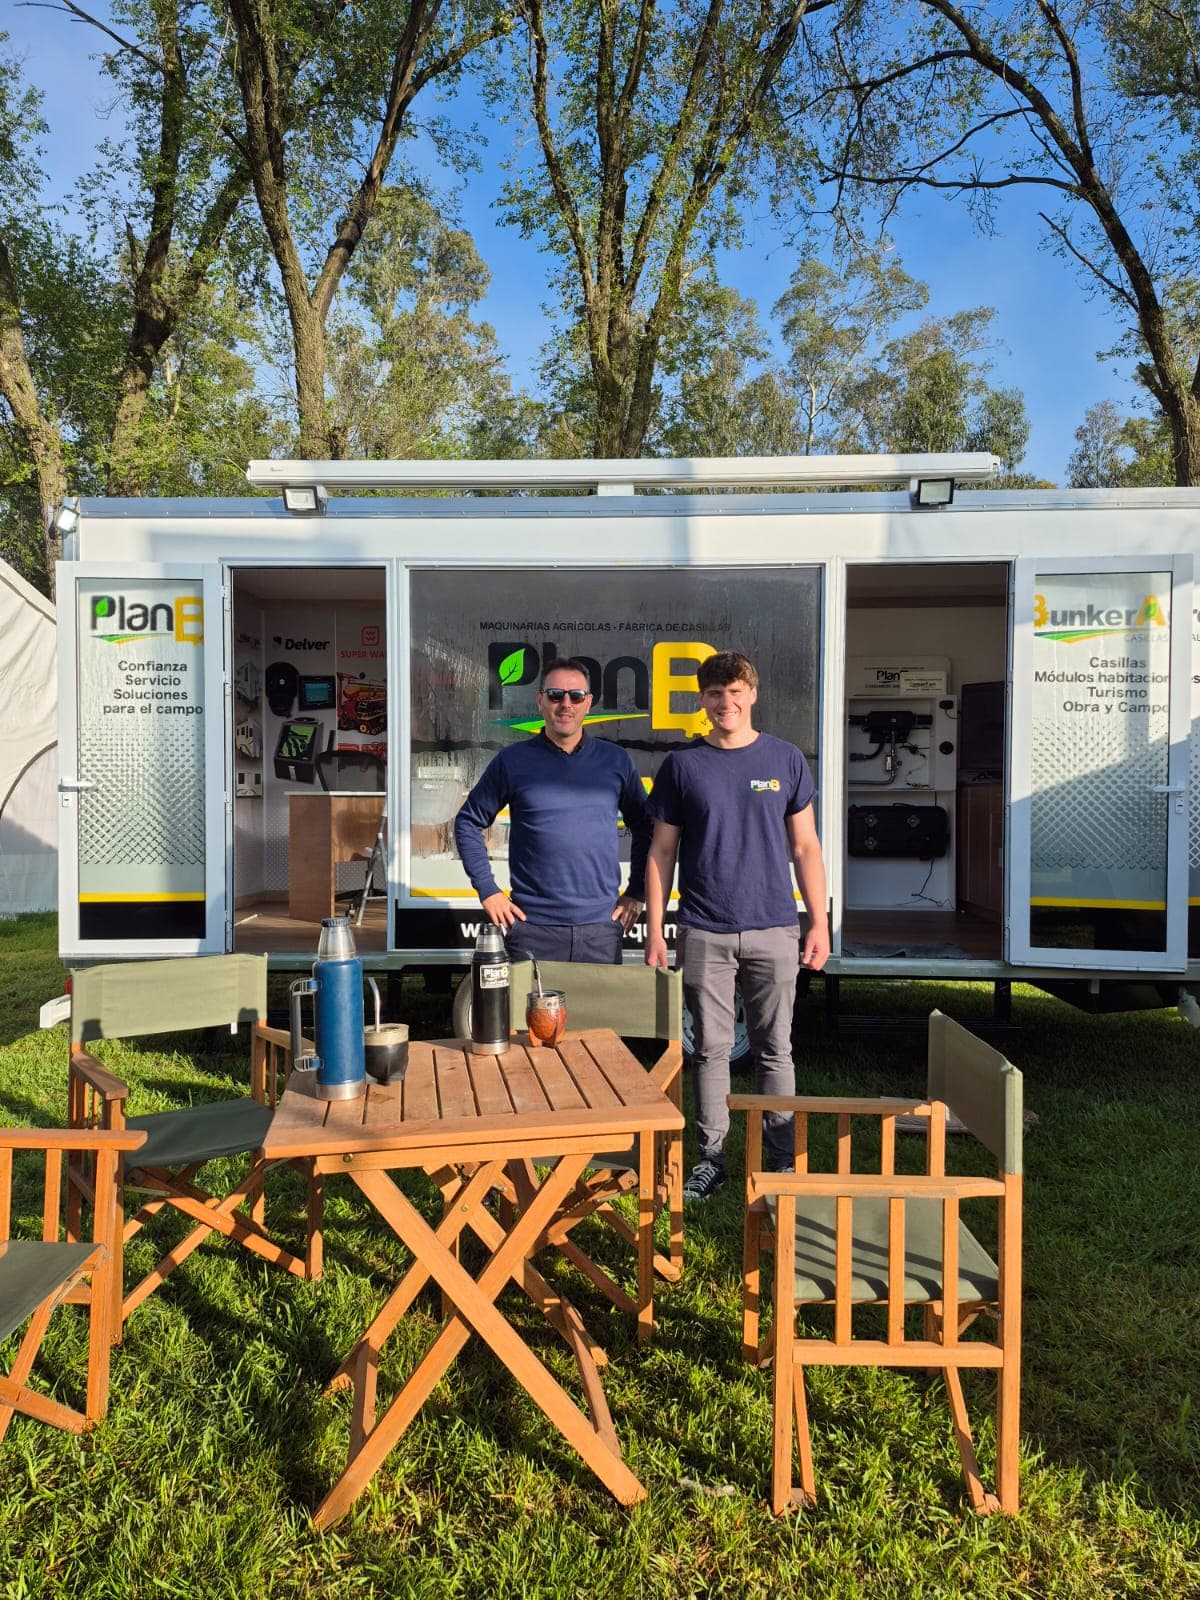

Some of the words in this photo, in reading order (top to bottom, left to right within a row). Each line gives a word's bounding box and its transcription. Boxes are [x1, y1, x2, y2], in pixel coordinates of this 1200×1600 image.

[90, 595, 204, 645] PlanB
[480, 621, 550, 631] MAQUINARIAS
[552, 620, 611, 631] AGRÍCOLAS
[665, 623, 680, 632] DE
[1123, 633, 1168, 642] CASLAS
[284, 638, 330, 650] Delver
[340, 650, 367, 658] SUPER
[118, 660, 188, 672] Confianza
[1089, 656, 1147, 668] Casillas
[125, 674, 181, 686] Servicio
[1034, 670, 1094, 683] Módulos
[113, 688, 189, 700] Soluciones
[488, 641, 718, 738] PnB
[1087, 686, 1148, 698] Turismo
[103, 705, 135, 715] para
[140, 704, 152, 714] el
[156, 705, 204, 716] campo
[1063, 701, 1100, 712] Obra
[1105, 703, 1113, 714] y
[1118, 702, 1168, 715] Campo
[750, 779, 780, 791] PlanB
